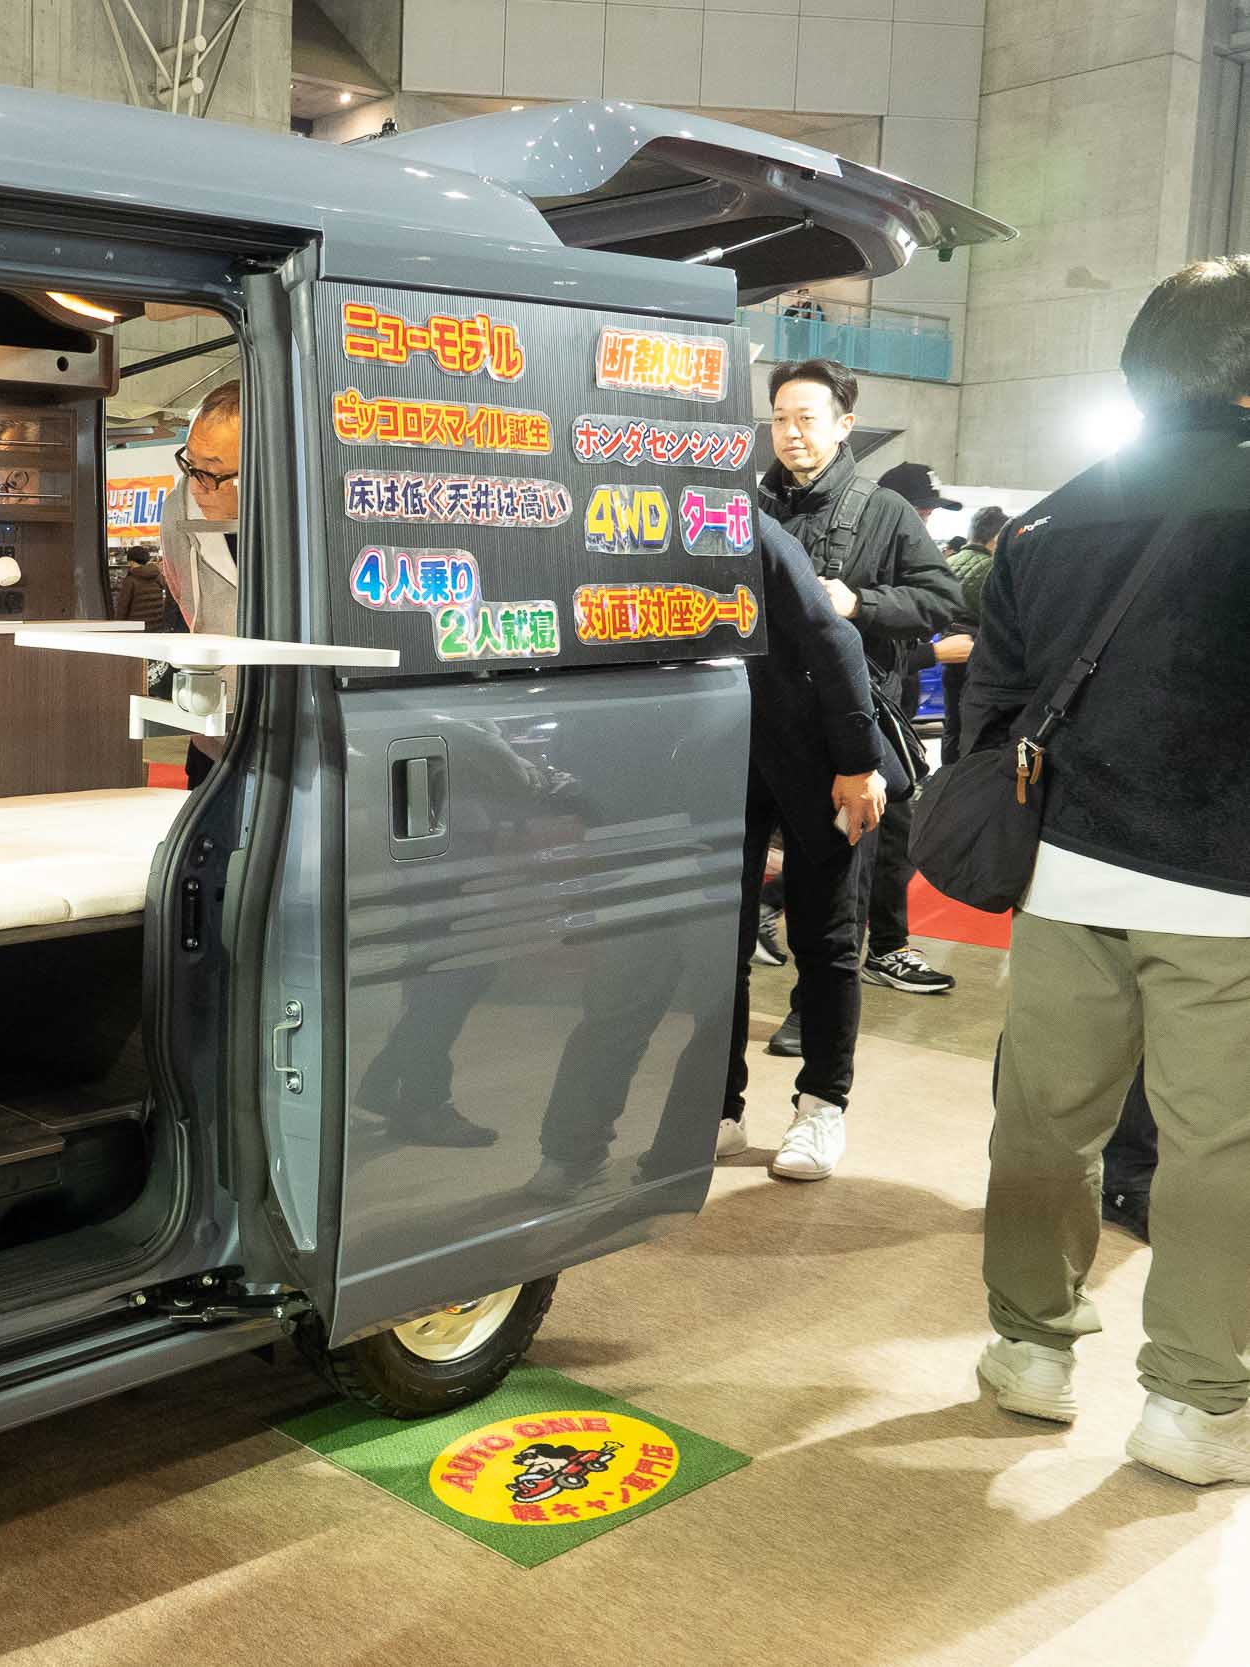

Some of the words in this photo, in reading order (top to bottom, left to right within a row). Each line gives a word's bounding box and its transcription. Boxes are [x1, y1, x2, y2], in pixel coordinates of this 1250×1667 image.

[344, 303, 523, 379] ニューモデル
[600, 332, 724, 394] 断熱処理
[333, 391, 551, 451] ピッコロスマイル誕生
[577, 422, 751, 466] ホンダセンシング
[348, 477, 568, 520] 床は低く天井は高い
[587, 489, 670, 545] 4WD
[681, 490, 751, 547] ターボ
[354, 551, 478, 604] 4人乗り
[438, 607, 558, 655] 2人就寝
[579, 586, 756, 640] 対面対座シート
[441, 1435, 514, 1493] AUTO
[512, 1417, 611, 1438] ONE
[508, 1443, 674, 1522] 軽キャン専門店
